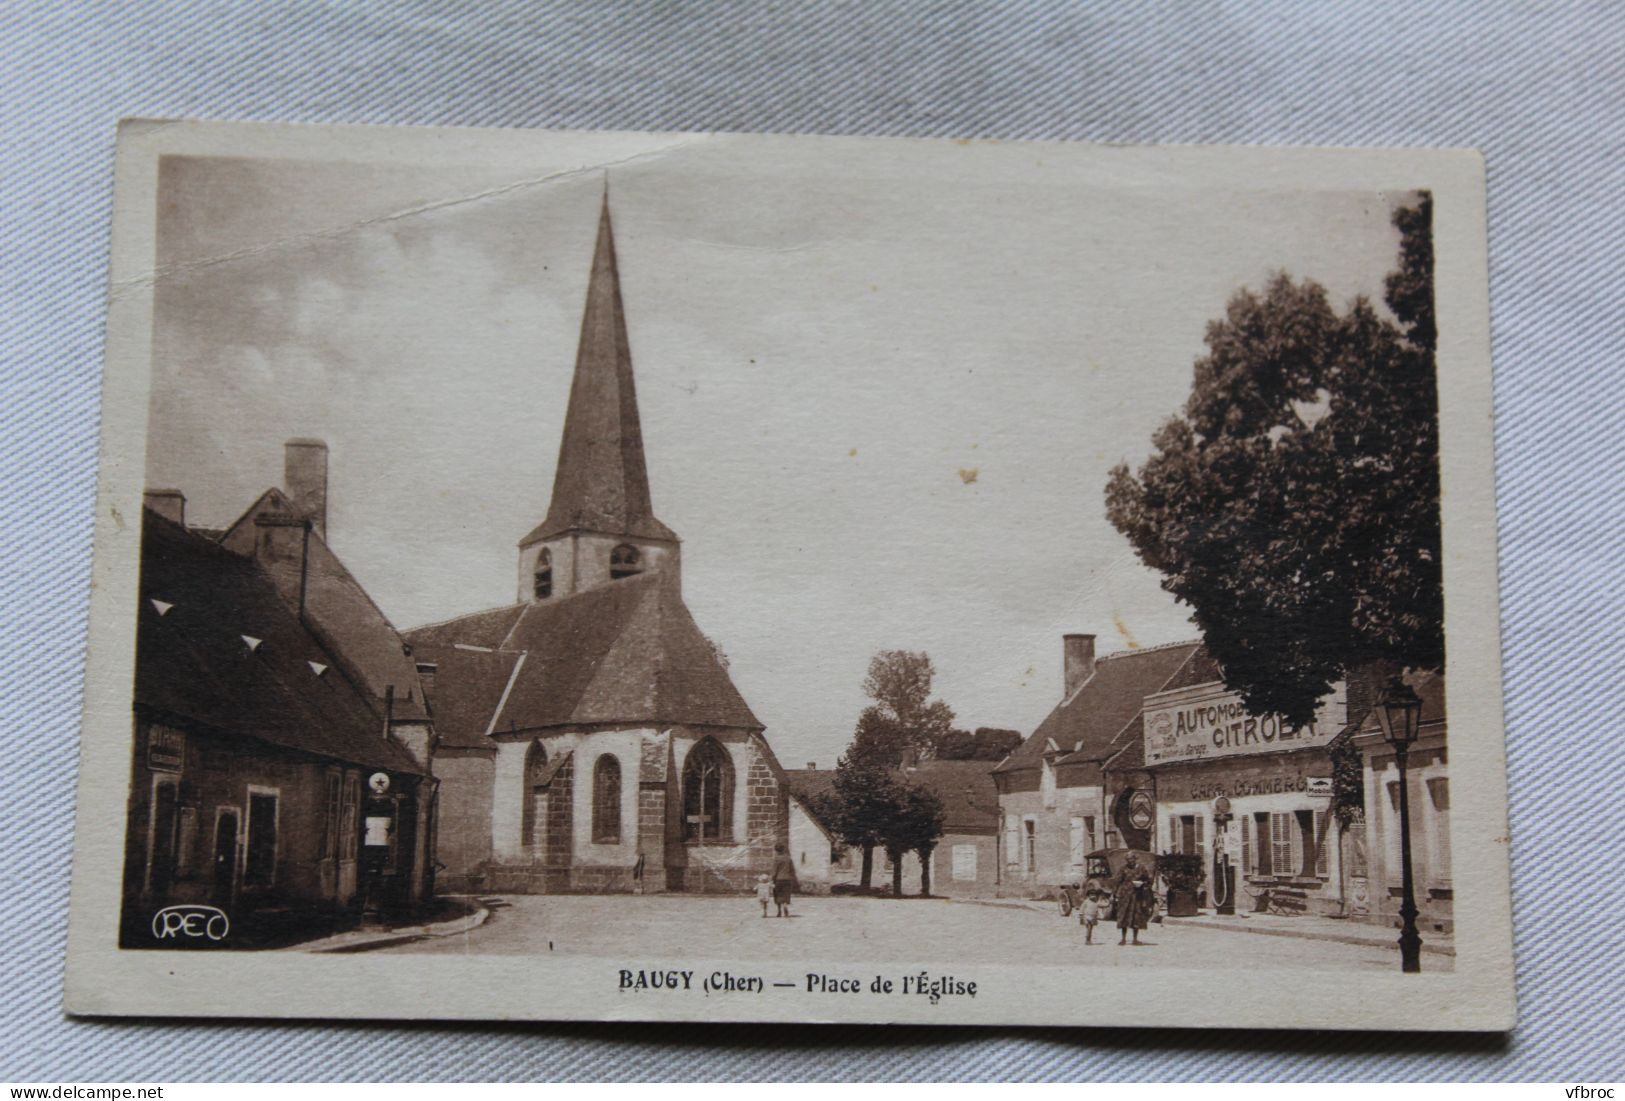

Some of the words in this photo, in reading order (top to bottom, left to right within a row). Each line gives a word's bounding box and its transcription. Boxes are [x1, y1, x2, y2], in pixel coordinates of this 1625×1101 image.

[1176, 702, 1245, 737] AUTOMOB
[618, 969, 693, 990] BAUGY
[703, 972, 763, 995] (Cher)
[806, 973, 860, 993] Place
[870, 974, 893, 994] de
[902, 971, 977, 1001] l'Église
